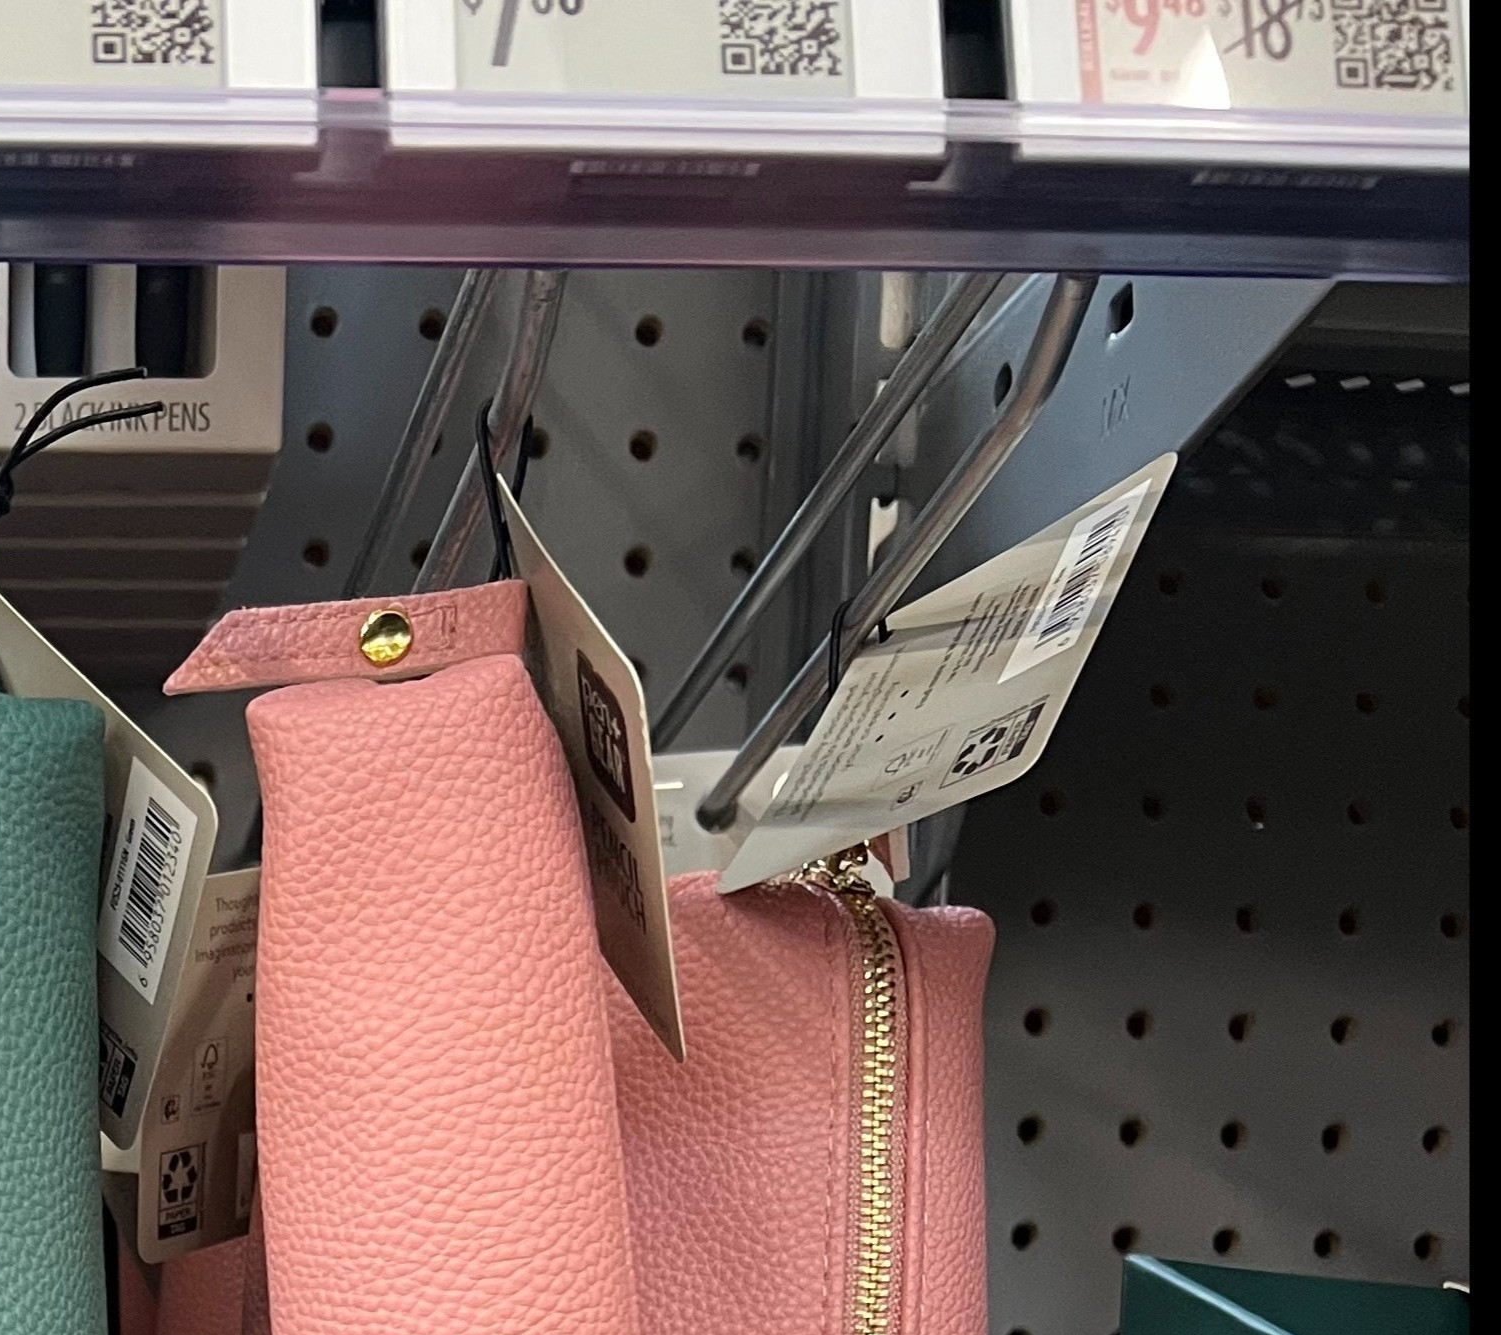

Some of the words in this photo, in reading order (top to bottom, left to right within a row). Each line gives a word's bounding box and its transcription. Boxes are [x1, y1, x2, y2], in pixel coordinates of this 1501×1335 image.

[15, 402, 27, 432] 2
[153, 402, 211, 432] PENS
[158, 832, 183, 898] 012340
[143, 899, 167, 965] 958037
[139, 975, 148, 988] 6
